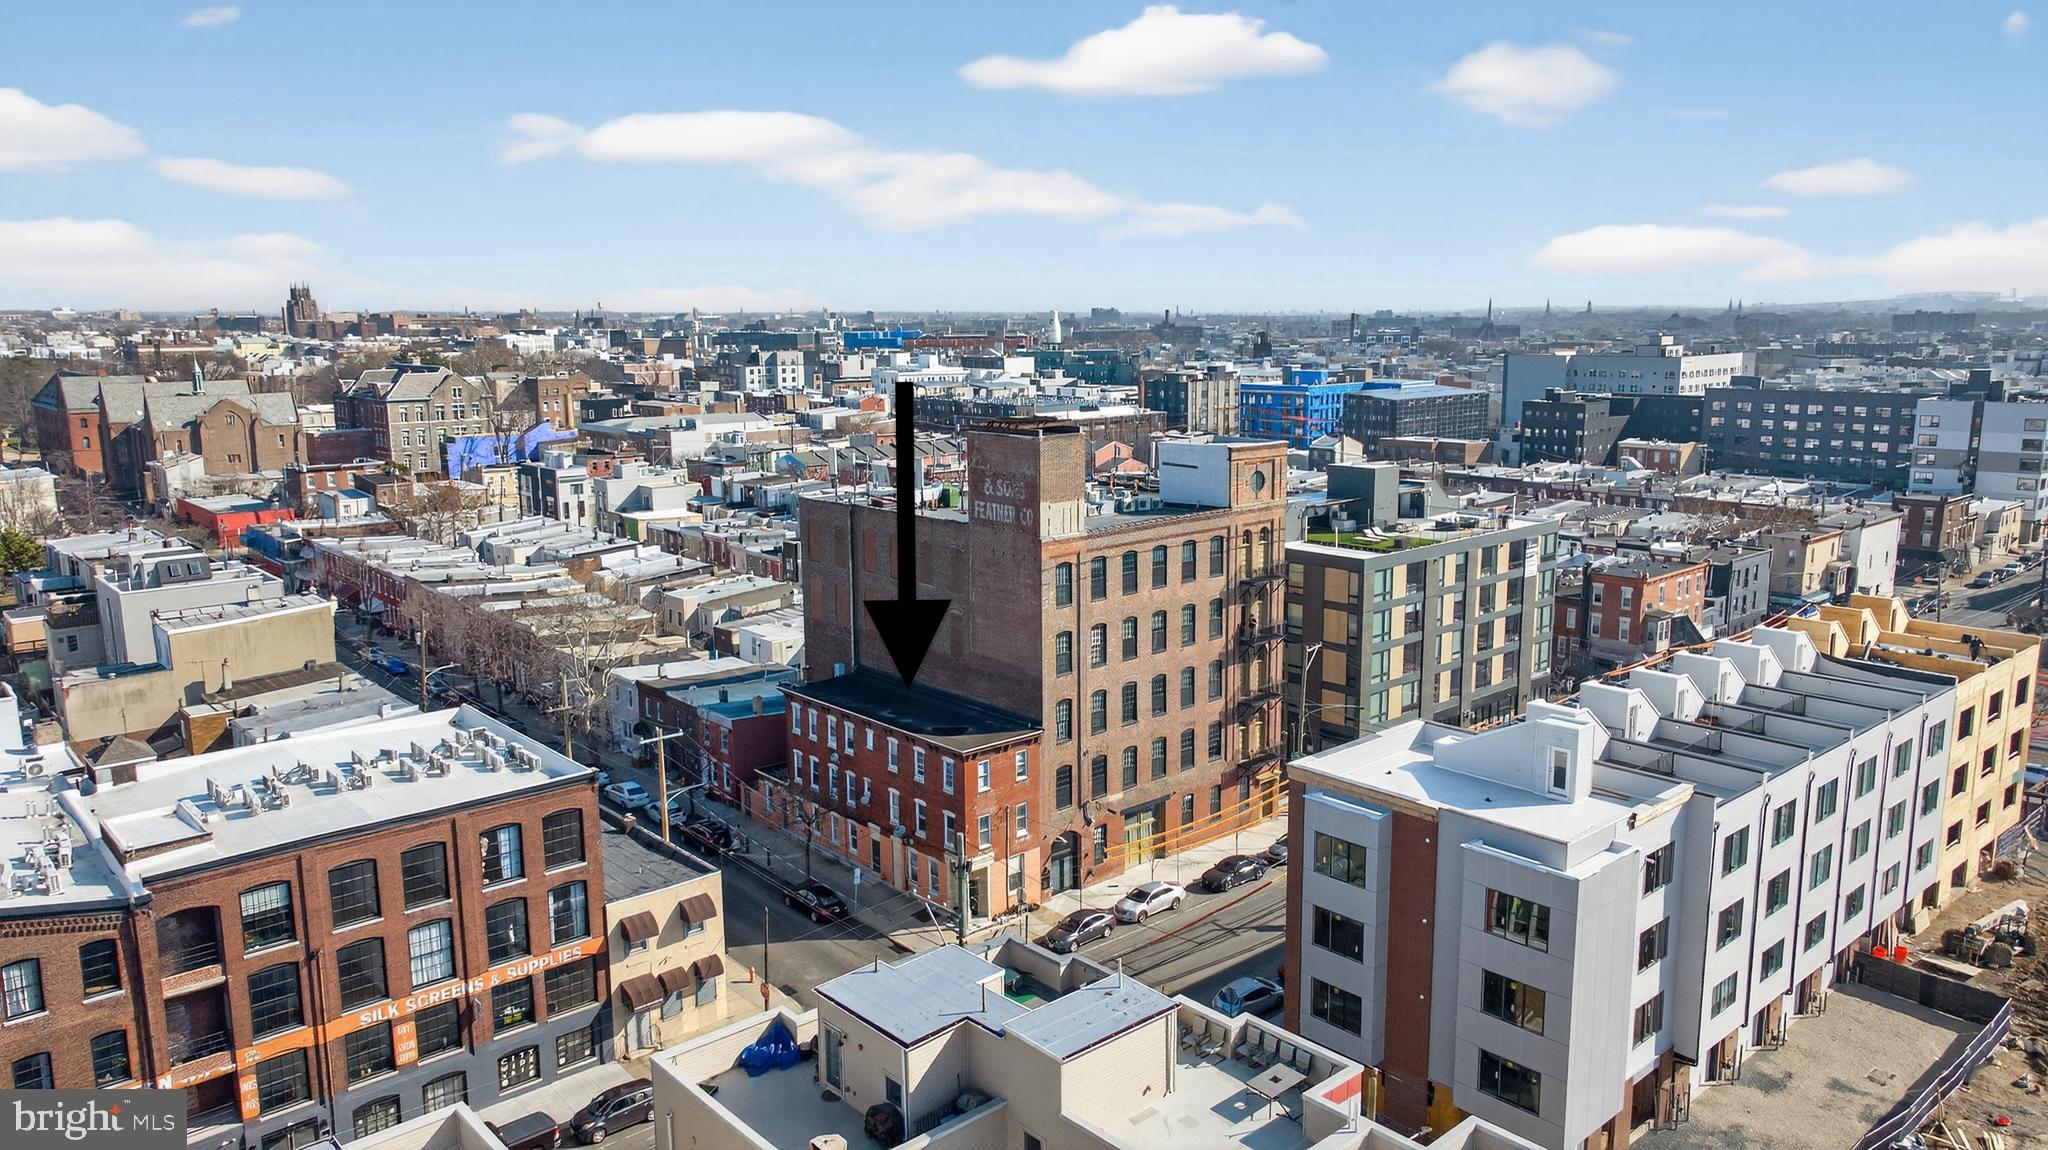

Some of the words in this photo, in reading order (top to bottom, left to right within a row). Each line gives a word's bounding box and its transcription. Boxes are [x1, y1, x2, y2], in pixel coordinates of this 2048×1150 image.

[974, 500, 1015, 524] FEATHER
[360, 1005, 400, 1026] SILK
[406, 979, 485, 1013] SCREENS
[490, 973, 501, 988] &
[507, 946, 582, 980] SUPPLIES
